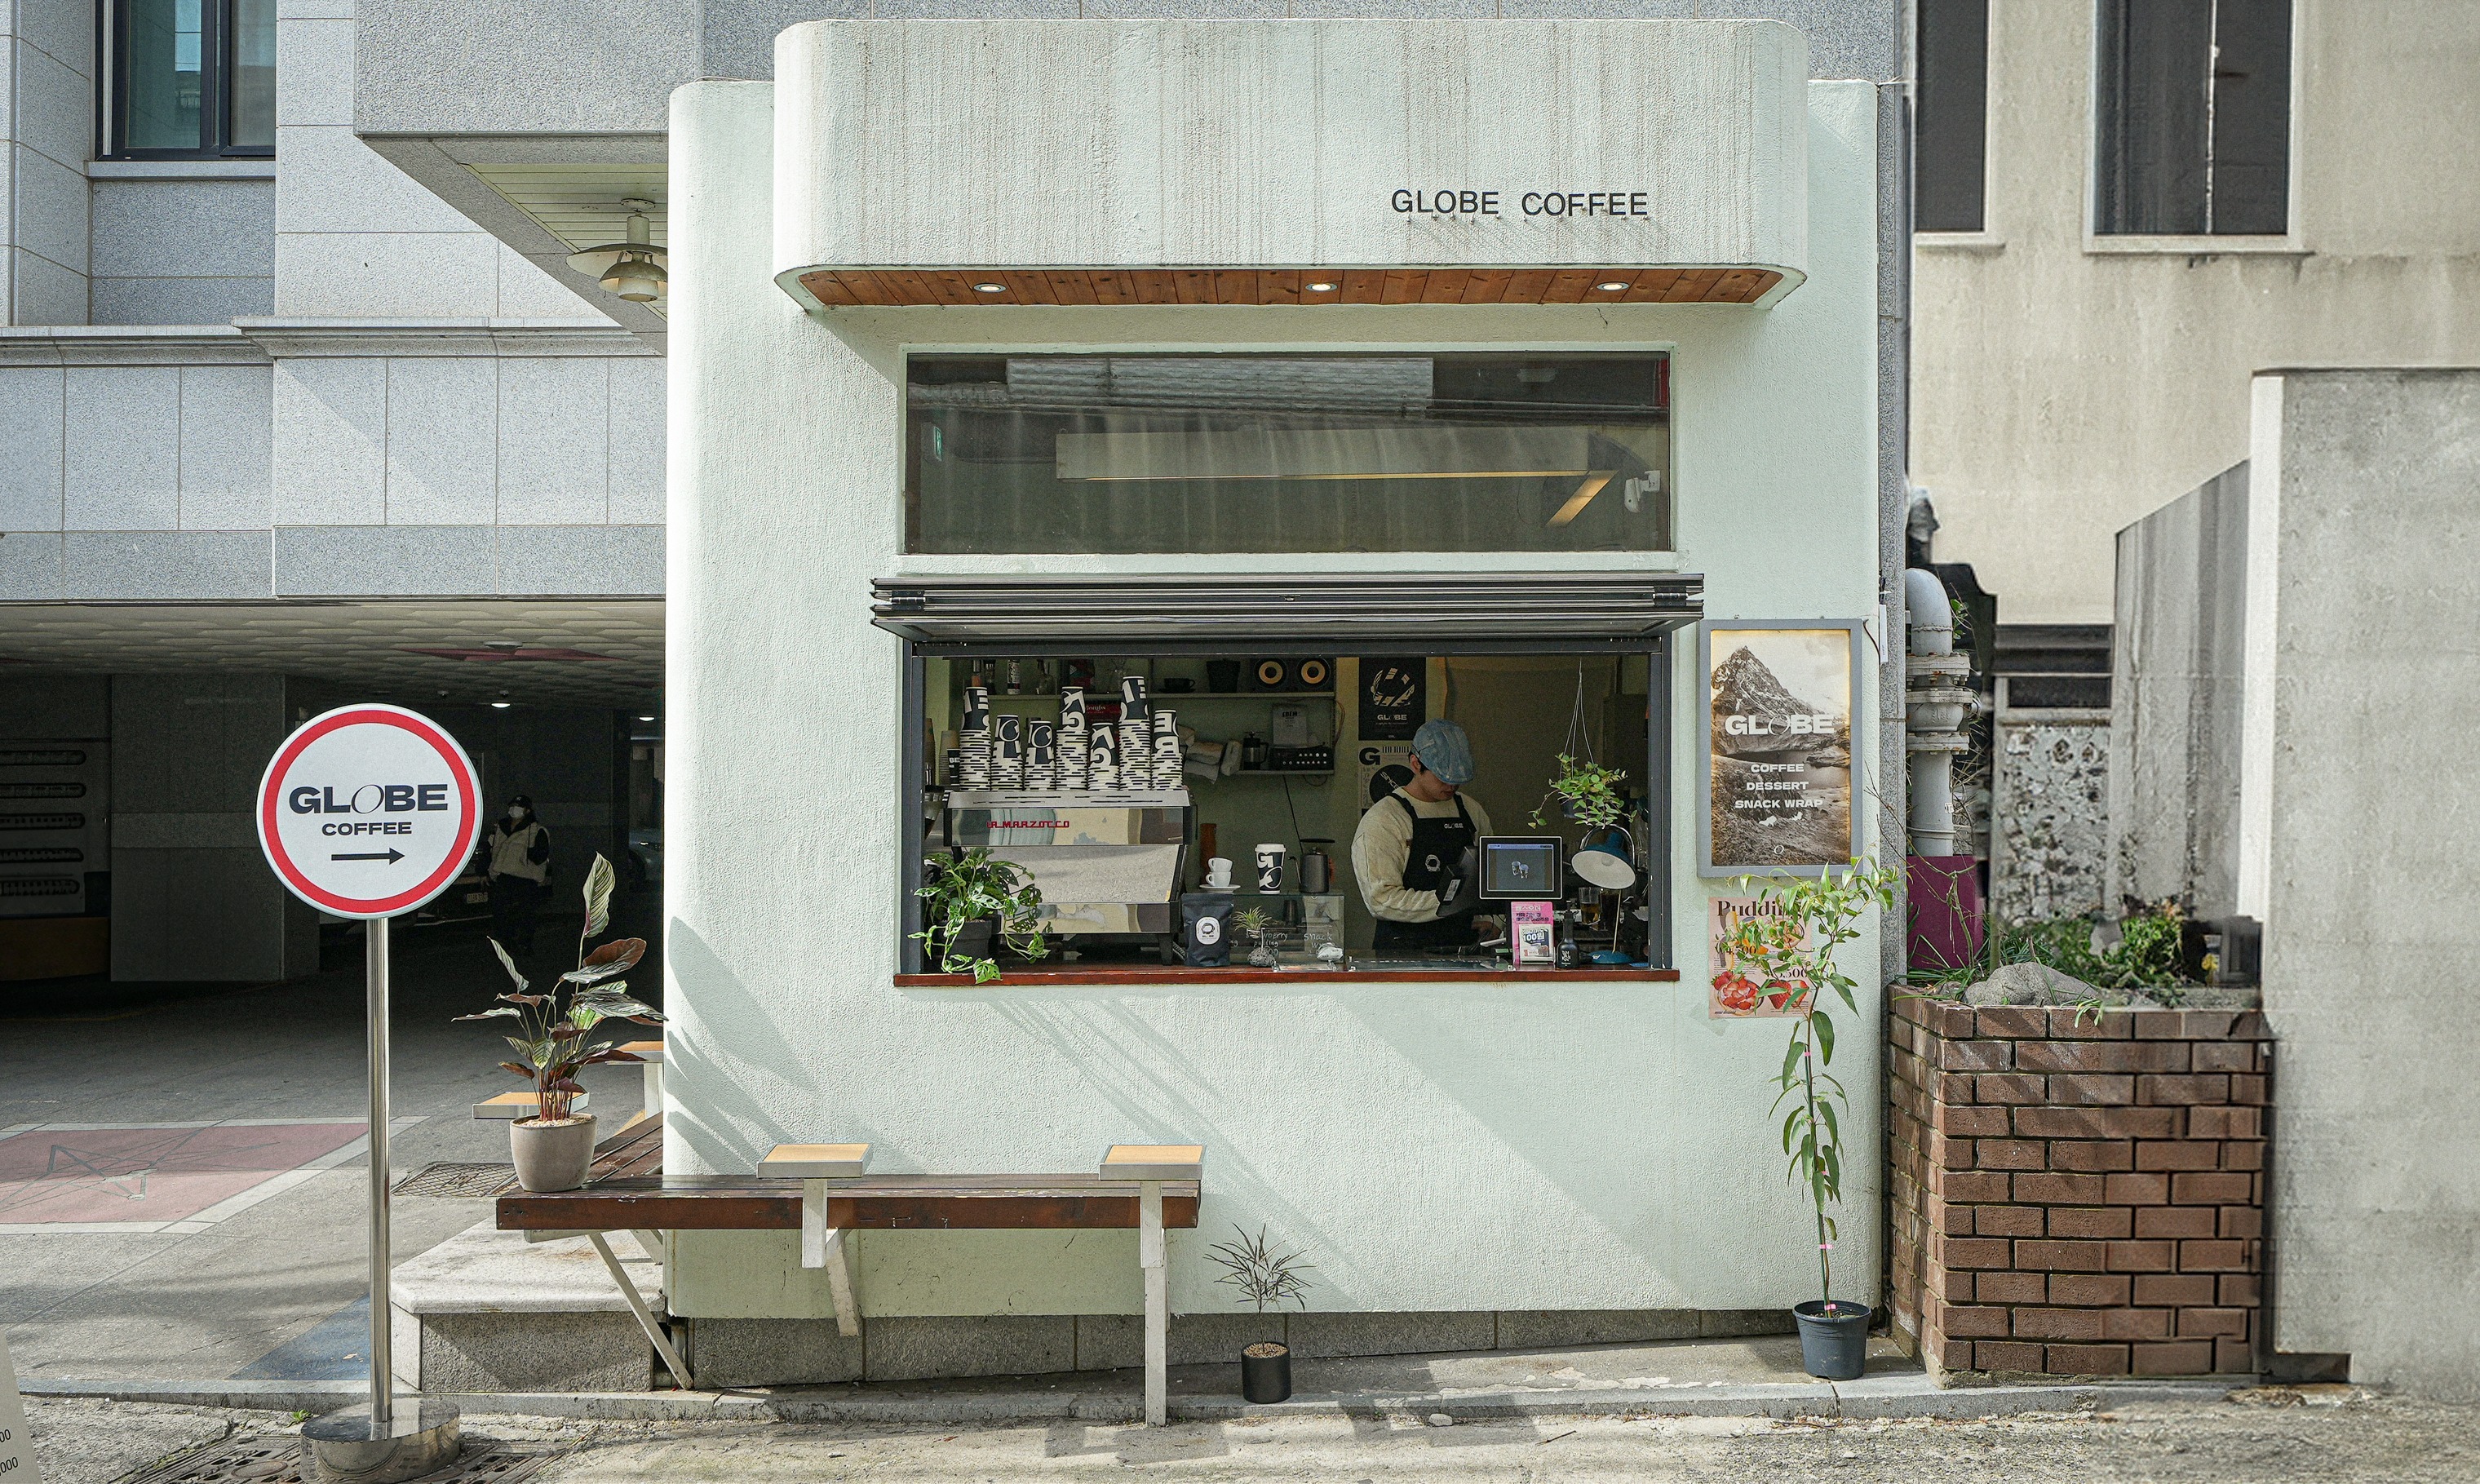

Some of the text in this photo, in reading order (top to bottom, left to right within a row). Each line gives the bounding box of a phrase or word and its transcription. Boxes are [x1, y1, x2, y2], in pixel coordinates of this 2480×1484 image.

[1391, 189, 1648, 217] GLOBE COFFEE
[1725, 714, 1835, 736] GLOBE
[1751, 764, 1805, 773] COFFEE
[1746, 781, 1809, 791] DESSERT
[288, 783, 449, 814] GLOBE
[1734, 799, 1823, 809] SNACK WRAP
[321, 822, 413, 836] COFFEE
